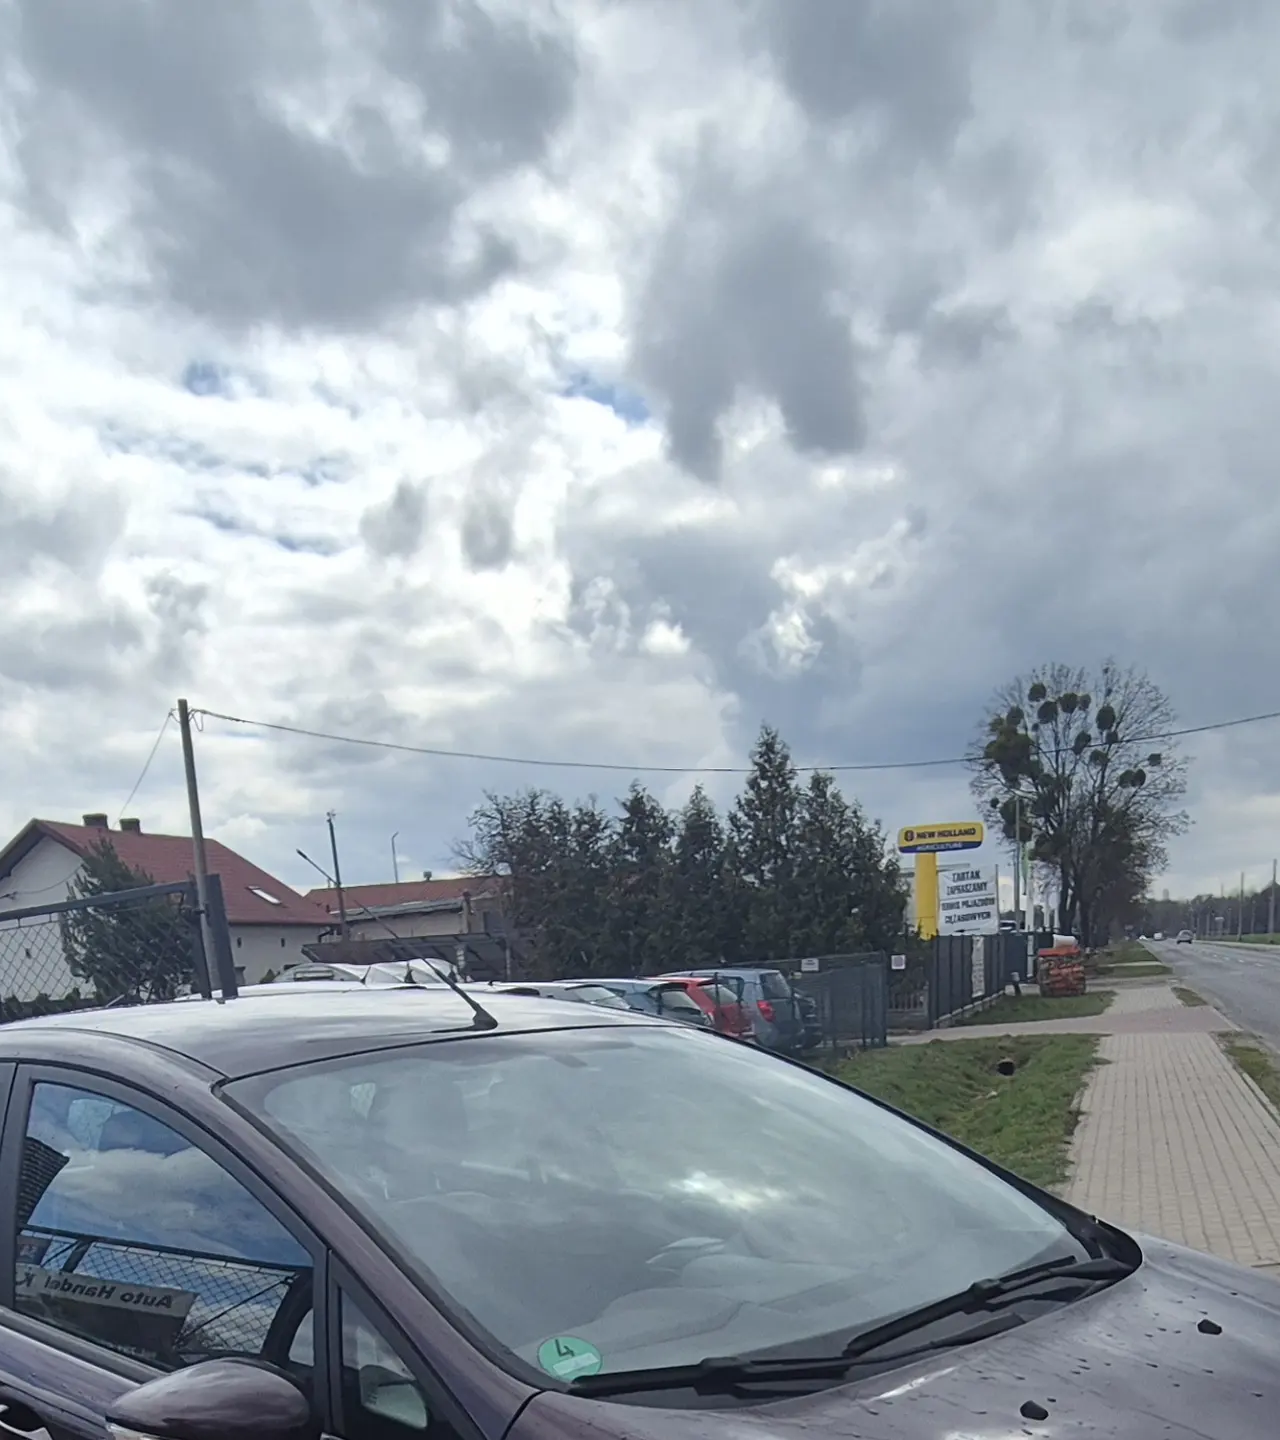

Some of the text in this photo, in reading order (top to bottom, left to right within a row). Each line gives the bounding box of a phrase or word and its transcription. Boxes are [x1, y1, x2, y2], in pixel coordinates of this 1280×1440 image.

[917, 828, 976, 839] NEW HOLLAND
[555, 1339, 575, 1357] 4
